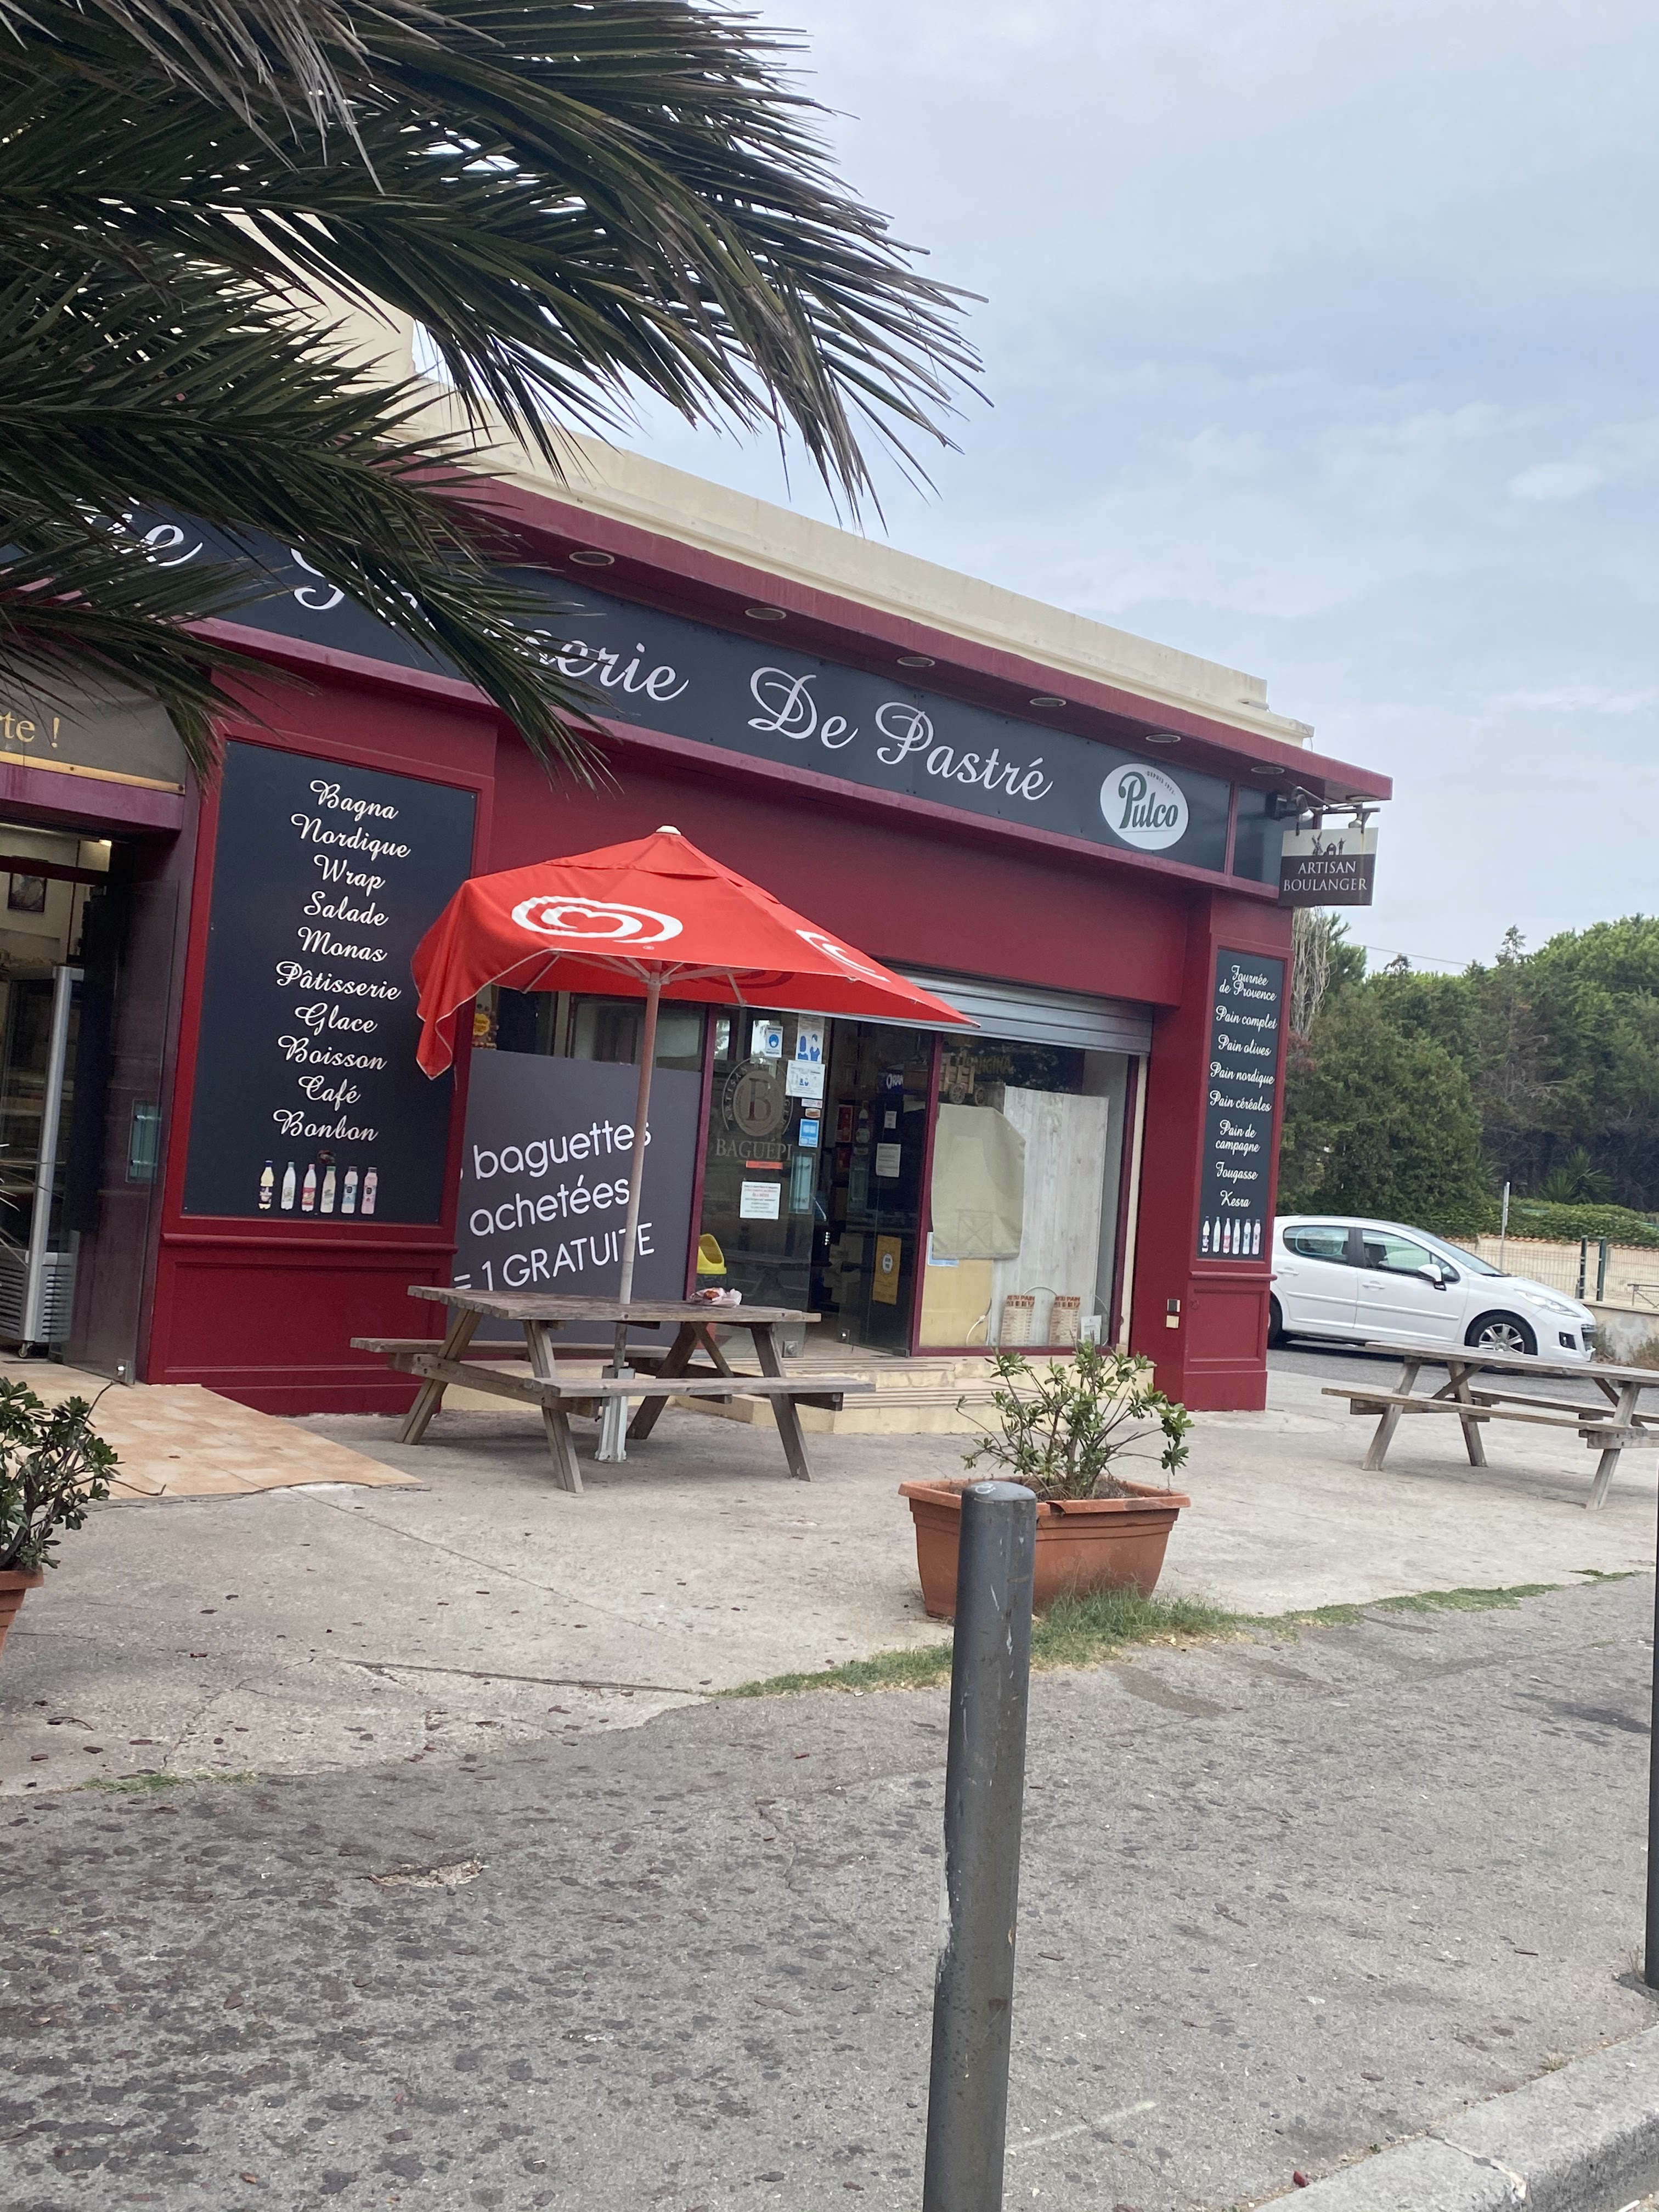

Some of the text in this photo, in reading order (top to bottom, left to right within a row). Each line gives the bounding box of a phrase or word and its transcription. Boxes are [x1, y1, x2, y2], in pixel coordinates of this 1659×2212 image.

[748, 666, 859, 749] De
[875, 702, 1053, 801] Pastré
[310, 780, 399, 822] Bagna
[1118, 771, 1178, 829] Pulco
[291, 813, 411, 861] Nordique
[313, 854, 386, 896] Wrap
[1298, 861, 1356, 874] ARTISAN
[1283, 878, 1367, 891] BOULANGER
[303, 890, 389, 926] Salade
[297, 926, 388, 962] Monas
[275, 961, 402, 1000] Pâtisserie
[1219, 979, 1277, 1001] de Provence
[295, 1002, 377, 1035] Glace
[1216, 1005, 1278, 1032] Pain complet
[278, 1035, 387, 1070] Boisson
[1218, 1034, 1272, 1056] Pain olives
[1210, 1062, 1274, 1088] Pain nordique
[298, 1075, 361, 1111] Café
[1210, 1090, 1272, 1112] Pain céréales
[273, 1109, 379, 1141] Bonbon
[1220, 1119, 1256, 1138] Pain de
[715, 1138, 793, 1161] BAGUÉPI
[1215, 1139, 1260, 1156] campagne
[1215, 1161, 1258, 1184] Fougasse
[470, 1175, 630, 1236] achetées
[1220, 1190, 1251, 1207] Kesra
